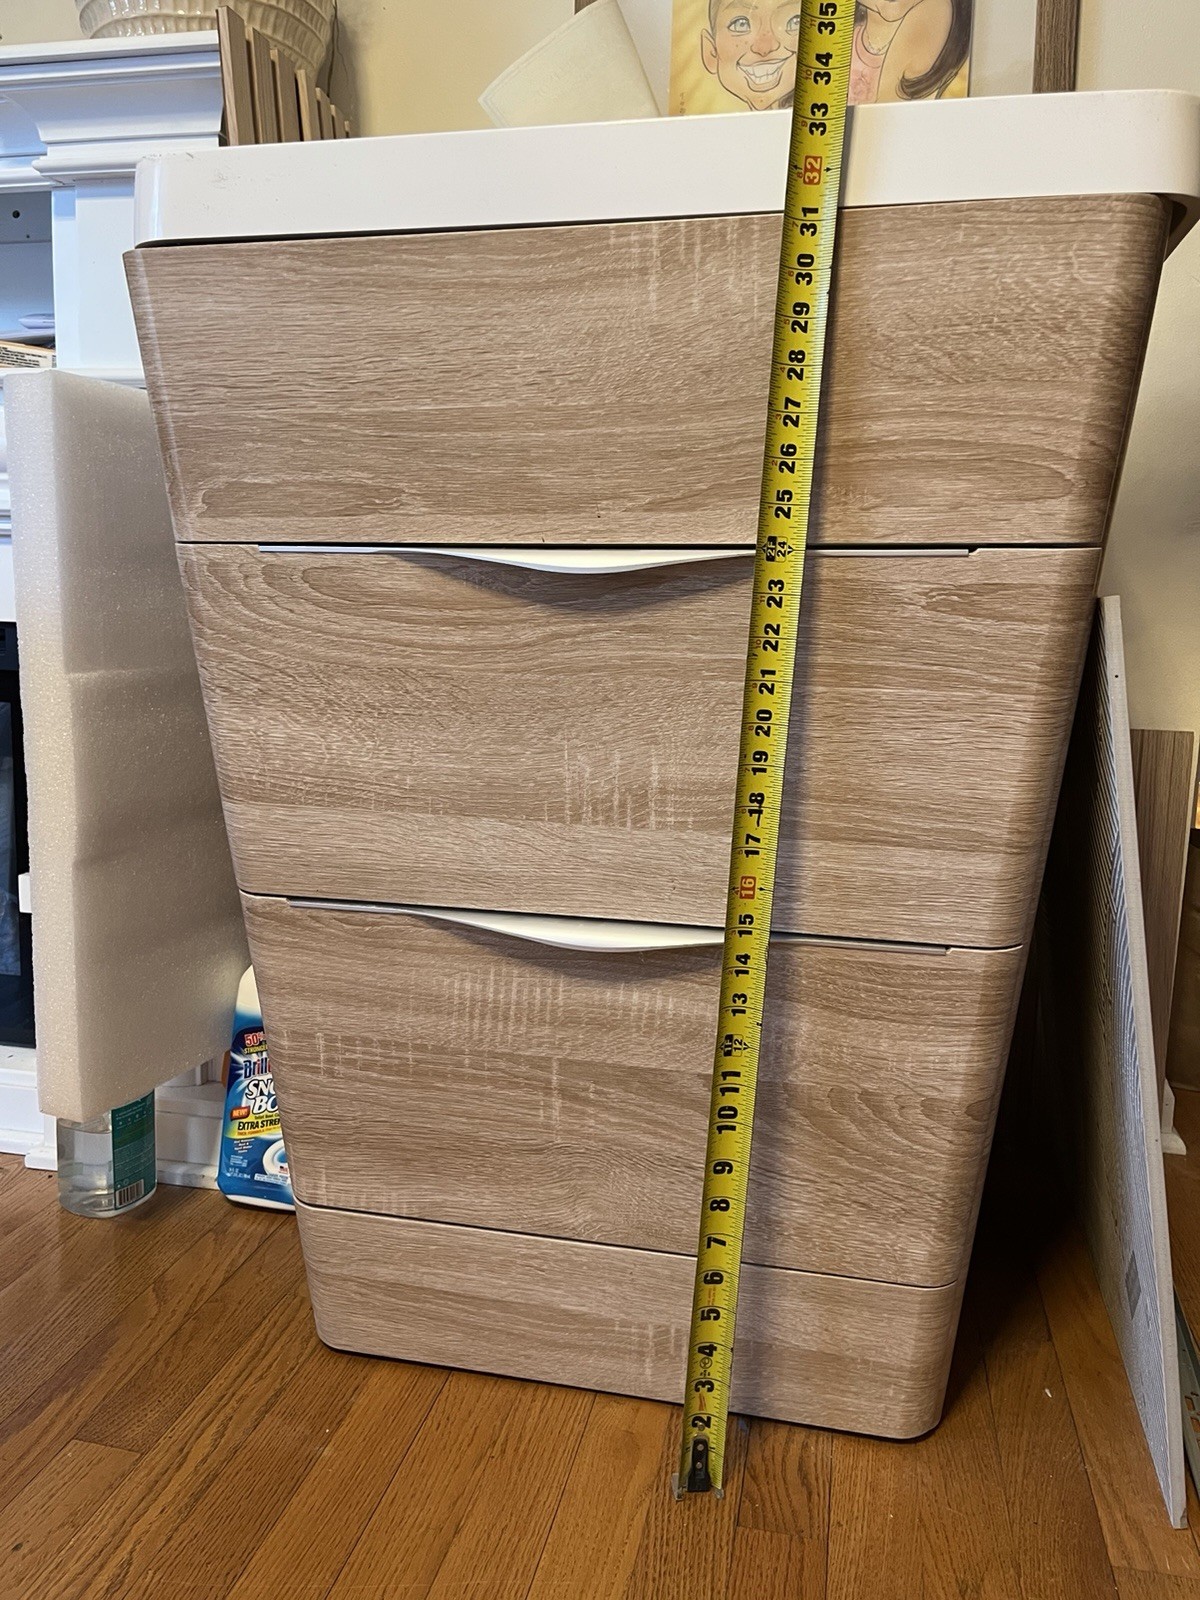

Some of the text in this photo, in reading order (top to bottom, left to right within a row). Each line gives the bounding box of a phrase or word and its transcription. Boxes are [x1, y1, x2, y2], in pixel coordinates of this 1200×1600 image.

[818, 2, 838, 35] 35
[813, 52, 833, 86] 34
[808, 102, 828, 136] 33
[804, 157, 821, 184] 32
[800, 206, 819, 238] 31
[795, 253, 814, 286] 30
[791, 302, 810, 334] 29
[786, 350, 806, 382] 28
[782, 396, 801, 428] 27
[778, 443, 797, 474] 26
[774, 489, 793, 520] 25
[766, 541, 776, 556] 2F
[776, 540, 787, 558] 24
[766, 579, 784, 609] 23
[762, 623, 780, 652] 22
[758, 668, 776, 696] 21
[754, 708, 772, 738] 20
[751, 750, 768, 776] 19
[748, 792, 765, 818] 18
[744, 833, 761, 858] 17
[740, 878, 755, 898] 16
[737, 914, 754, 938] 15
[734, 953, 751, 978] 14
[730, 993, 748, 1017] 13
[734, 1038, 742, 1052] 12
[720, 1070, 741, 1096] 11
[238, 1121, 259, 1130] EXTRA
[716, 1105, 738, 1134] 10
[713, 1161, 734, 1175] 9
[710, 1198, 730, 1212] 8
[706, 1236, 727, 1249] 7
[703, 1272, 724, 1285] 6
[700, 1308, 722, 1322] 5
[697, 1344, 718, 1358] 4
[694, 1380, 714, 1392] 3
[691, 1416, 712, 1429] 2
